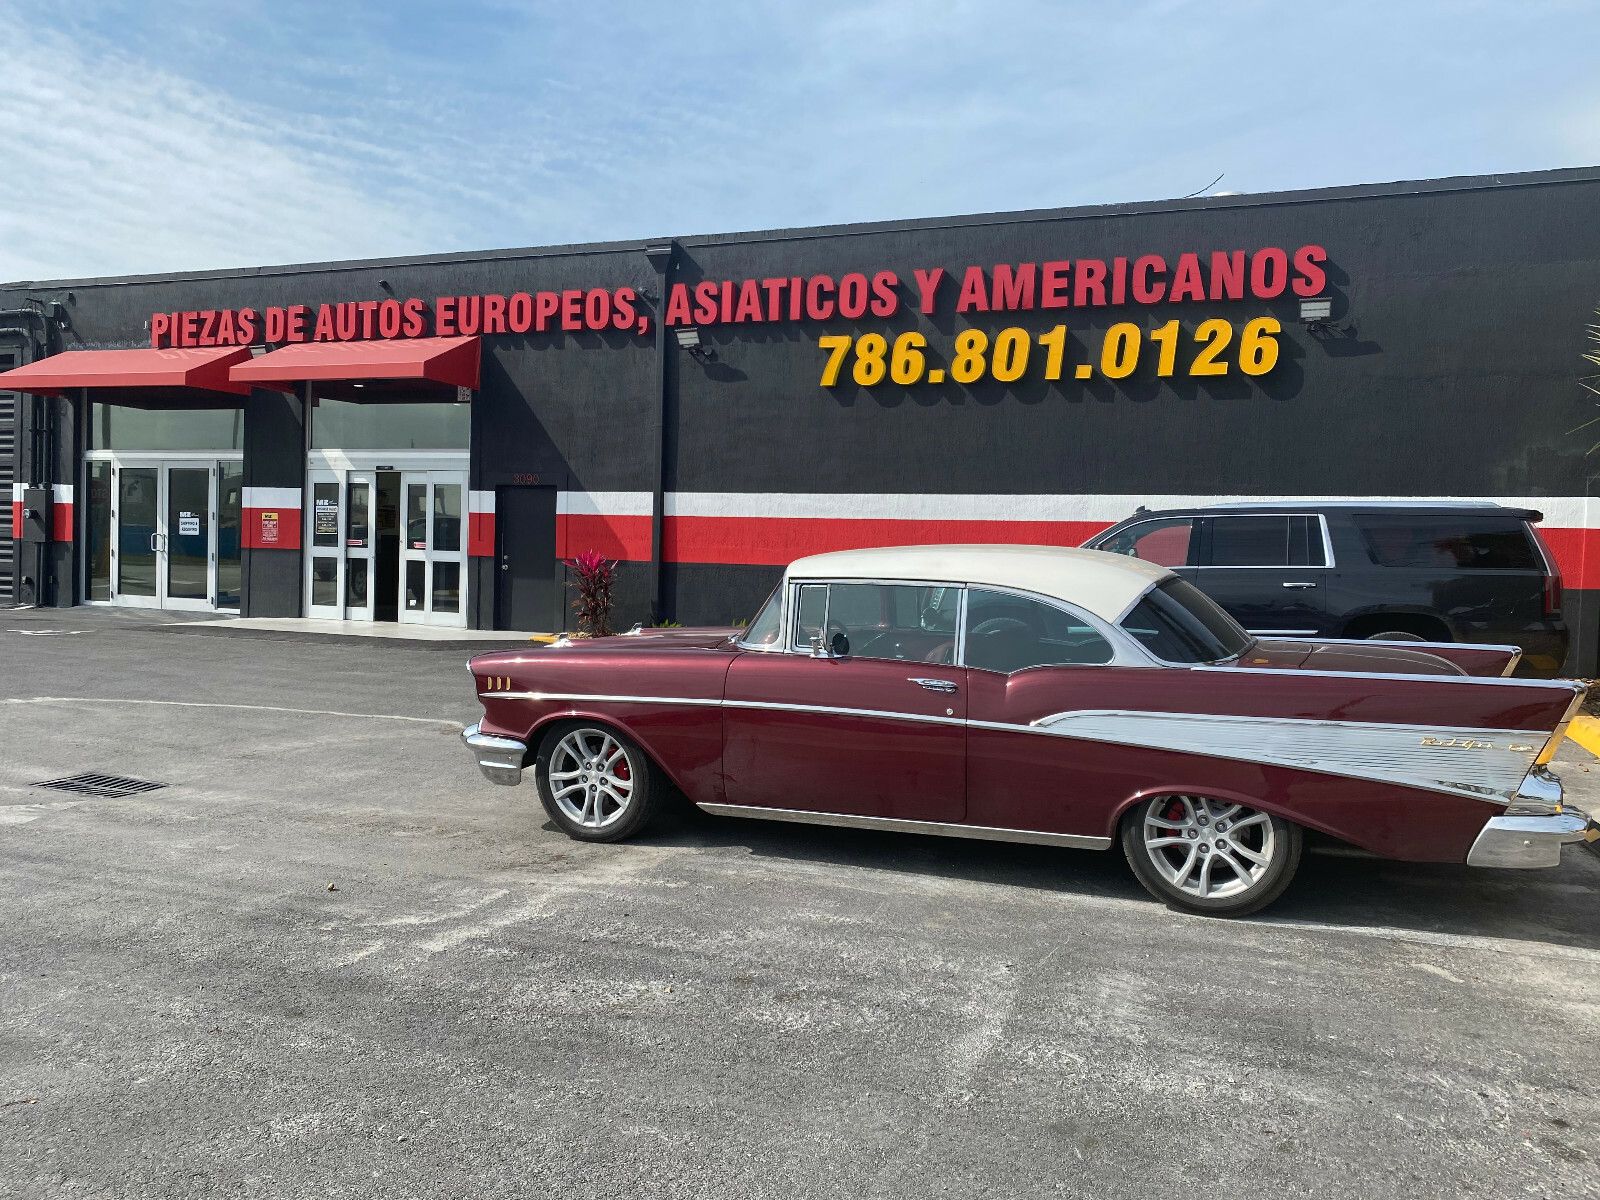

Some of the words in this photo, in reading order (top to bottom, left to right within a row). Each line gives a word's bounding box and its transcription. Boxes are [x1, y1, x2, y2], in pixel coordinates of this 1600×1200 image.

[152, 307, 257, 348] PIEZAS
[265, 304, 309, 343] DE
[314, 297, 425, 342] AUTOS
[436, 286, 649, 336] EUROPEOS,
[665, 270, 899, 326] ASIATICOS
[913, 267, 945, 315] Y
[956, 244, 1328, 313] AMERICANOS
[818, 316, 1282, 387] 786.801.0126
[513, 473, 540, 485] 3090
